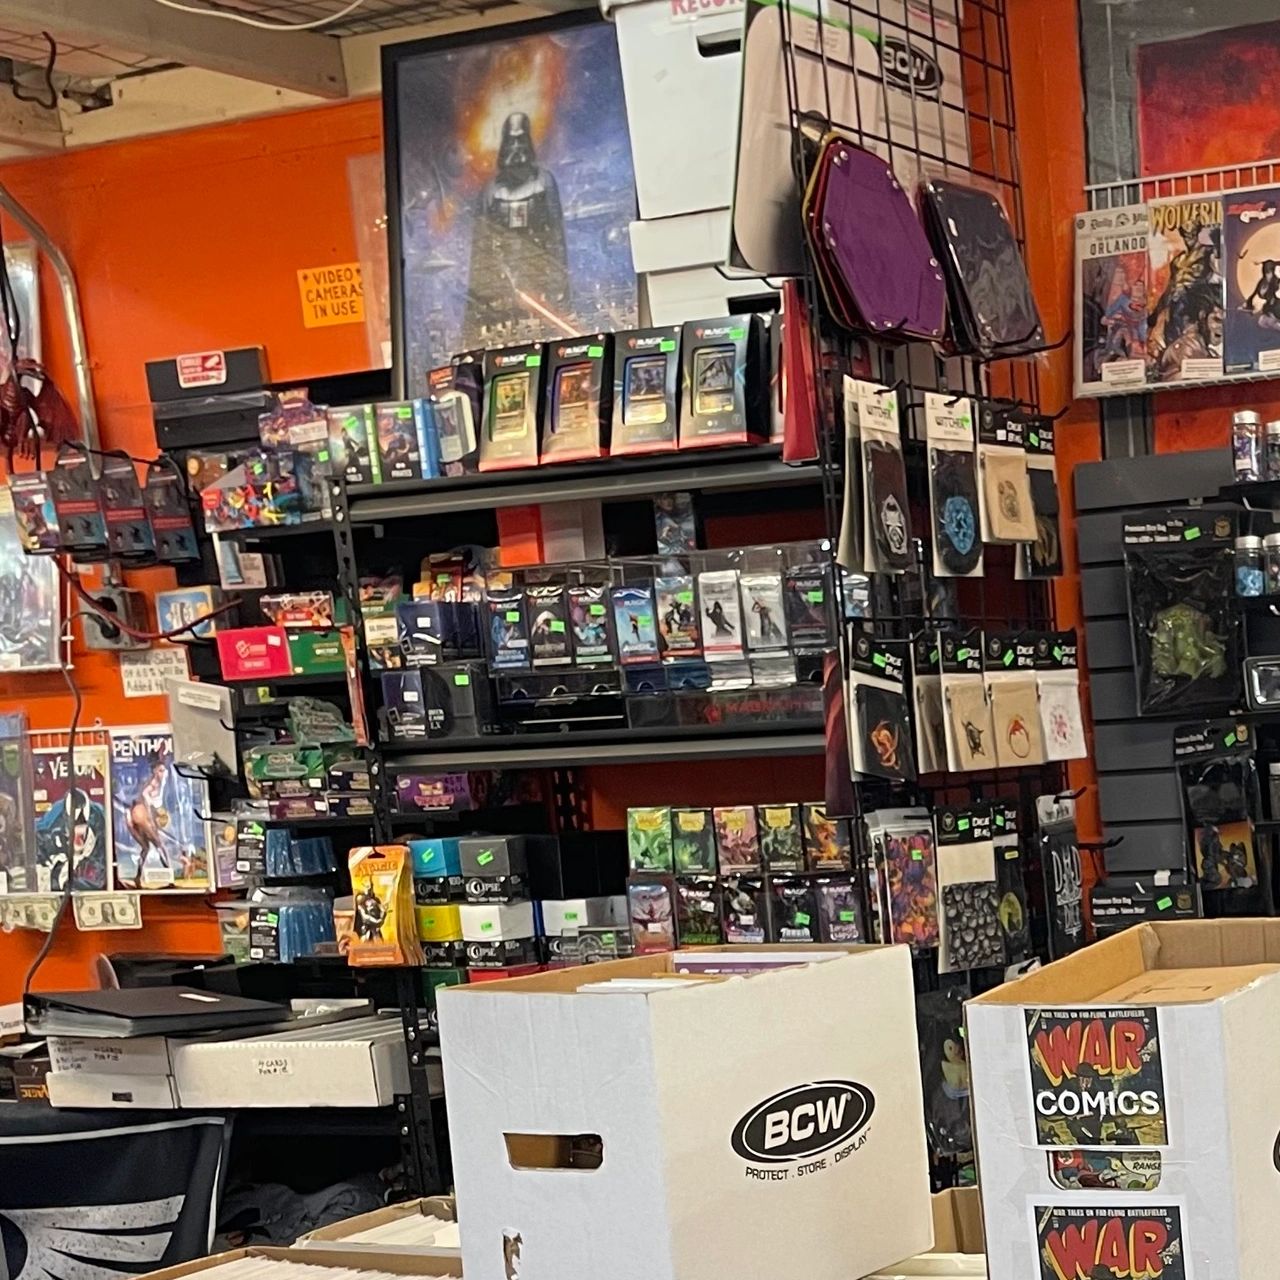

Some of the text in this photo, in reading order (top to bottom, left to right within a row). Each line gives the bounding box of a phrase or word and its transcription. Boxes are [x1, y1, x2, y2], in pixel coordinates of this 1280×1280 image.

[1089, 236, 1146, 255] ORLANDO
[312, 267, 354, 286] VIDEO
[305, 282, 364, 304] CAMERAS
[313, 301, 359, 320] IN USE
[49, 757, 96, 780] VEOM
[1034, 1018, 1147, 1087] WAR
[1036, 1090, 1161, 1116] COMICS
[764, 1092, 848, 1150] BCW
[745, 1159, 827, 1181] PROTECT STORE
